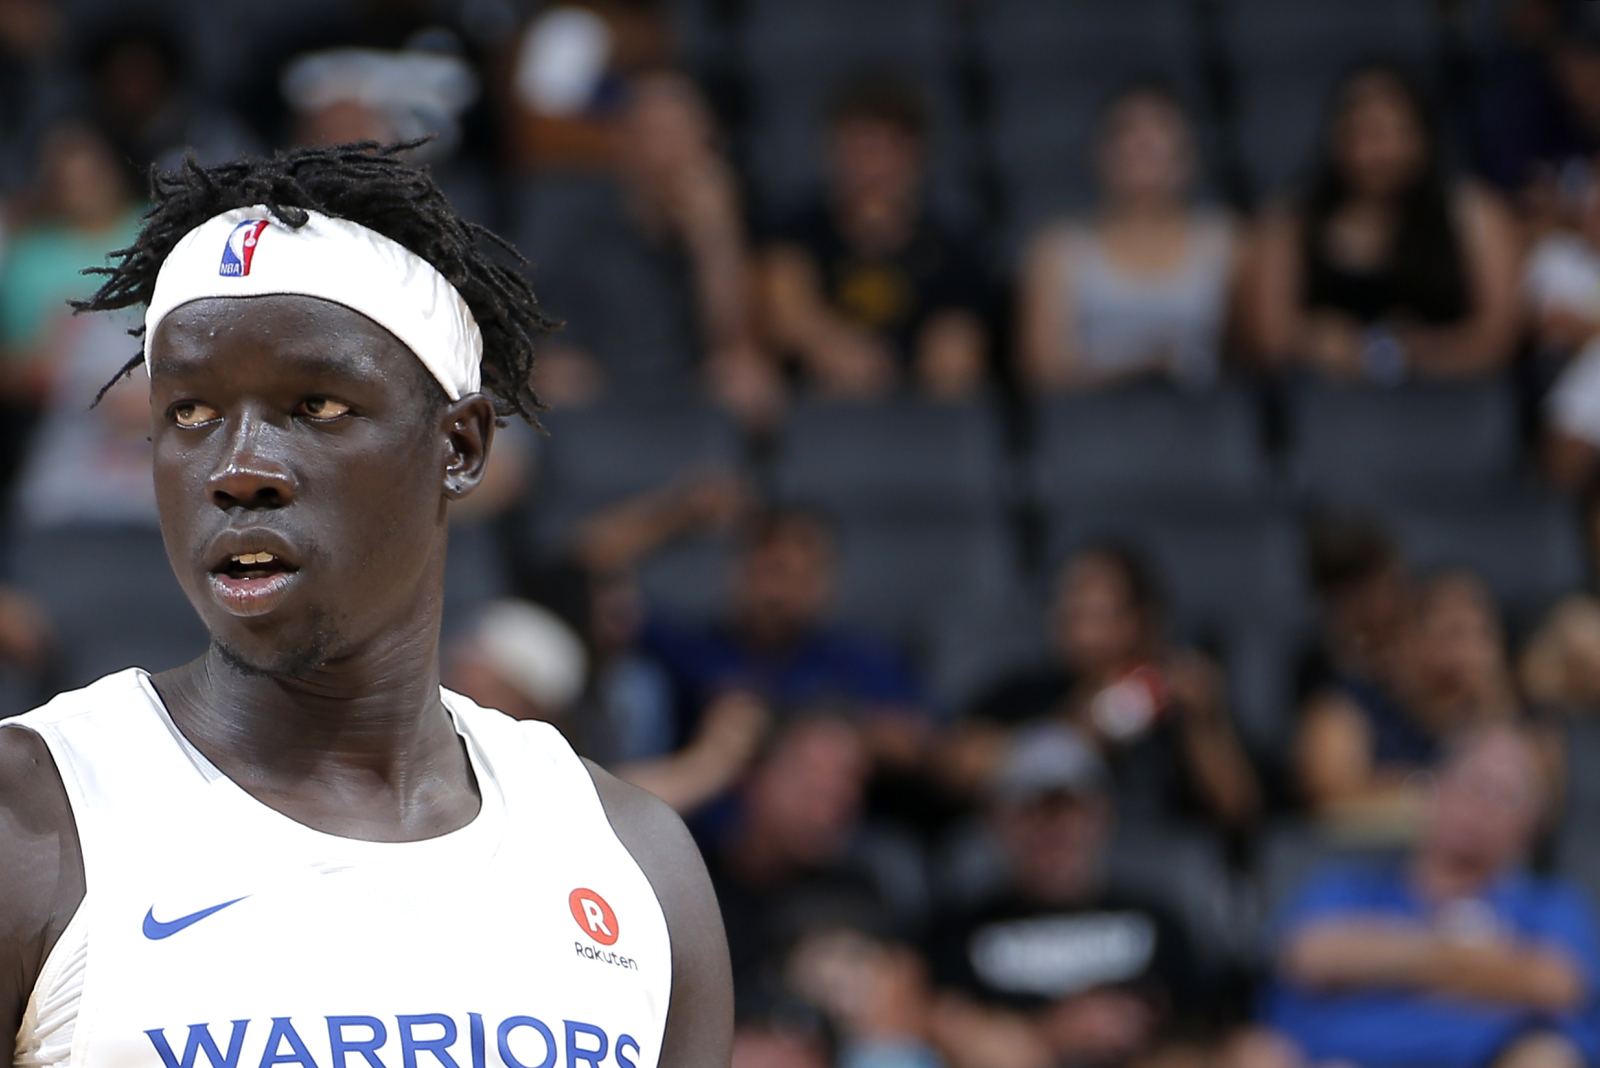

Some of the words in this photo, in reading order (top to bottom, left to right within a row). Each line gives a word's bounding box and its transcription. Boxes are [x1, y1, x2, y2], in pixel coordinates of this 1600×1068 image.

[220, 263, 240, 275] NBA
[580, 898, 613, 936] R
[574, 941, 638, 971] Rakuten
